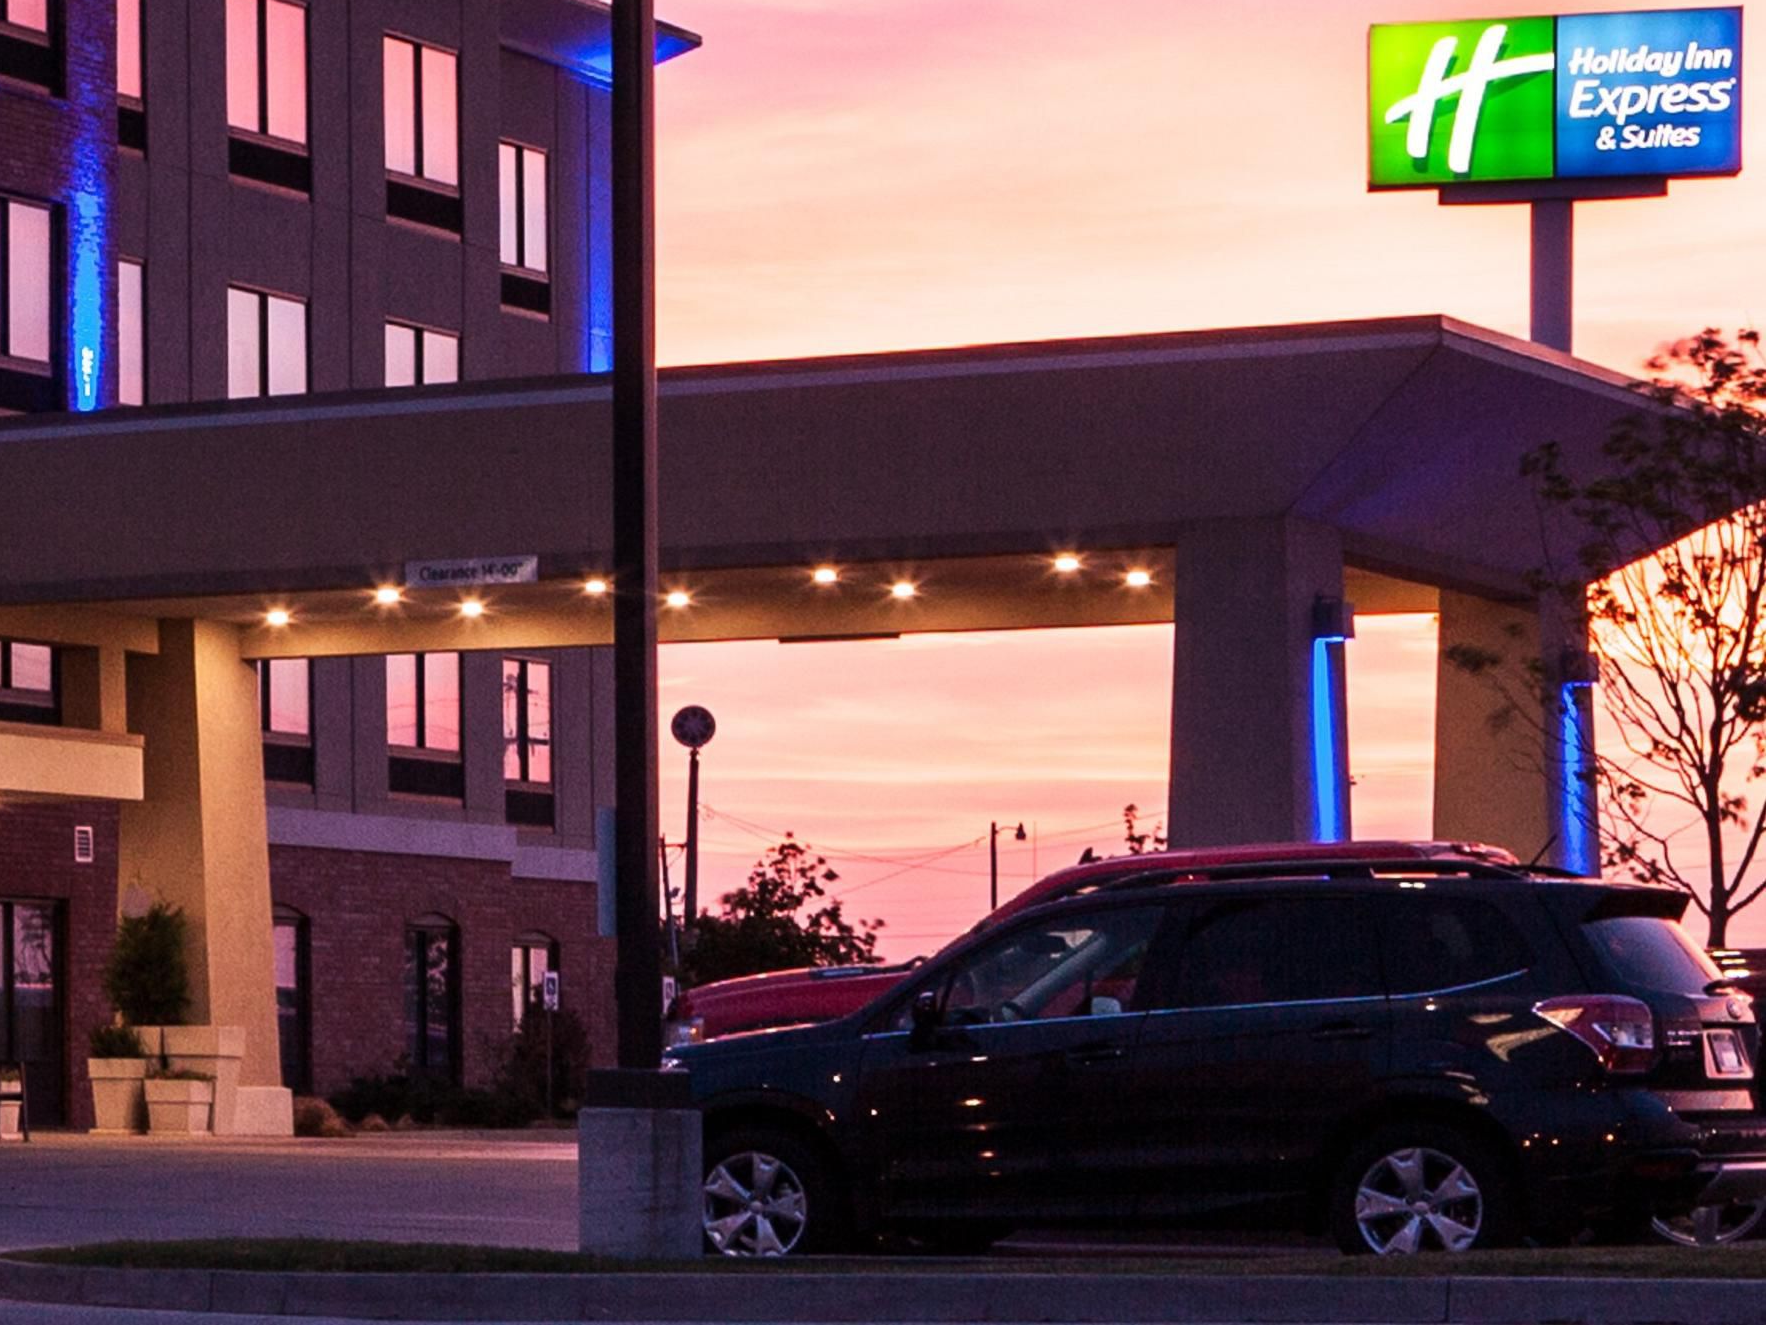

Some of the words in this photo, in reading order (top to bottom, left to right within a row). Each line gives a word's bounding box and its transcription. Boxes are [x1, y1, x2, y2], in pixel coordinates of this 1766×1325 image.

[1568, 44, 1684, 77] Holiday
[1683, 41, 1733, 70] Inn
[1567, 78, 1733, 125] Express
[1595, 125, 1617, 151] &
[1619, 123, 1701, 151] Suites
